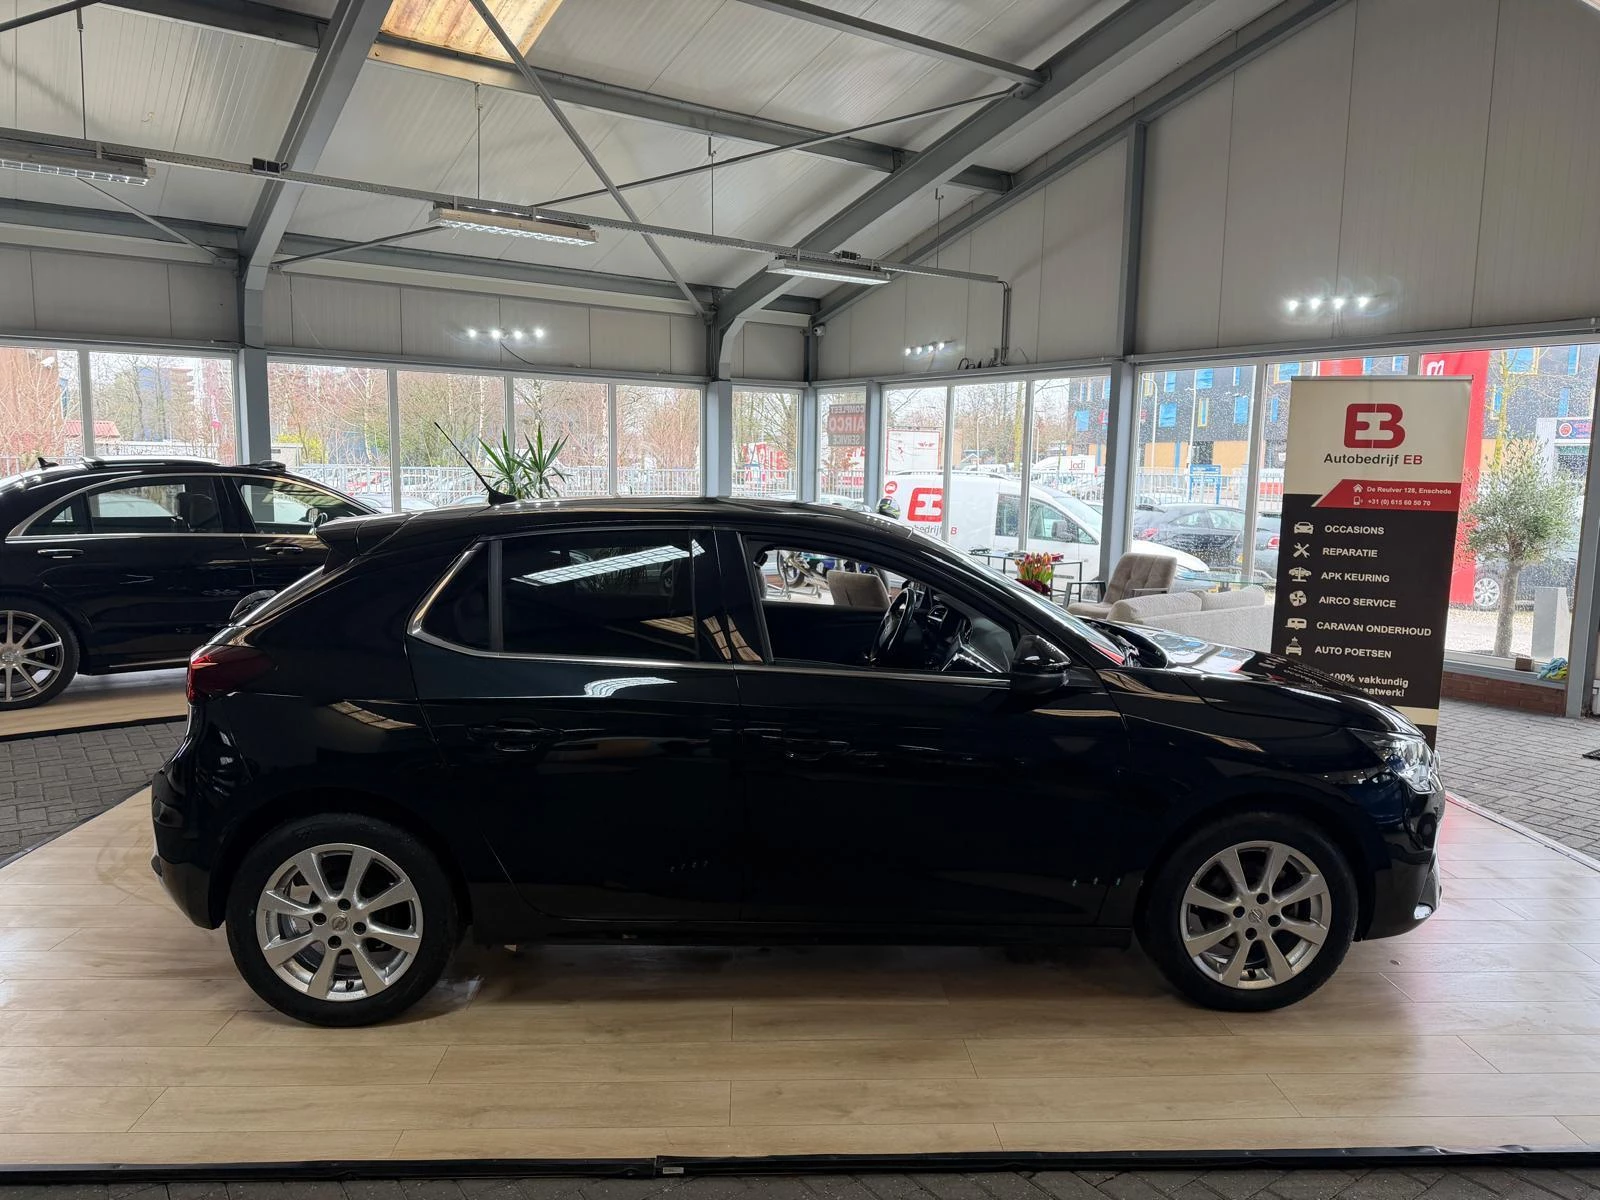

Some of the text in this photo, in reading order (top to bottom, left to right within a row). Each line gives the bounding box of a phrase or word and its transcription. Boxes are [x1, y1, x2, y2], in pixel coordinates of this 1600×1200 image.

[1343, 403, 1406, 449] EB
[1323, 453, 1423, 467] Autobedrijf EB
[1324, 525, 1385, 535] OCCASIONS
[1322, 547, 1378, 558] REPARATIE
[1320, 571, 1390, 583] APK KEURING
[1319, 596, 1397, 608] AIRCO SERVICE
[1316, 621, 1432, 637] CARAVAN ONDERHOUD
[1315, 646, 1392, 658] AUTO POETSEN
[1358, 675, 1409, 689] vakkundig
